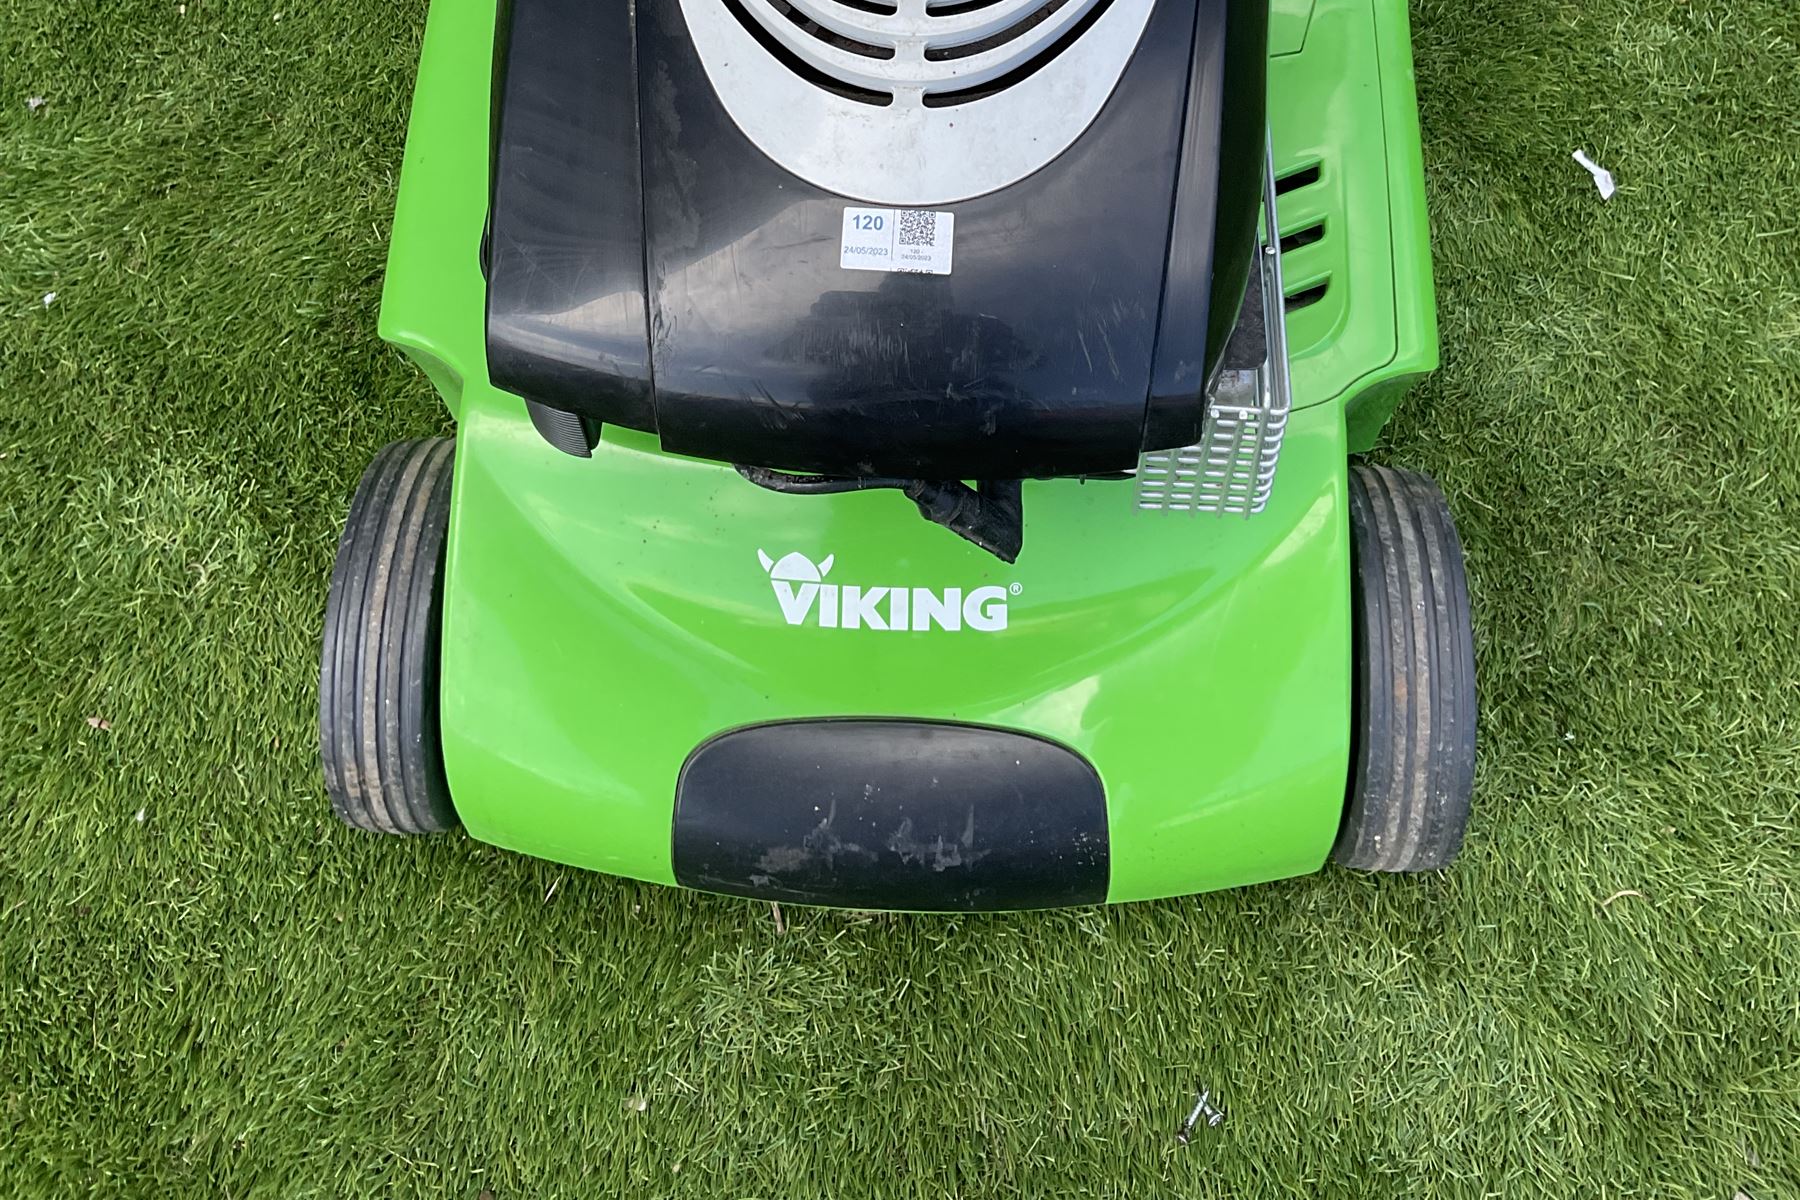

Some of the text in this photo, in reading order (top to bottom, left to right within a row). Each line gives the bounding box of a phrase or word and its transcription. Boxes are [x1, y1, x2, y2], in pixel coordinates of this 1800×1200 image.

[852, 214, 884, 231] 120
[843, 246, 889, 256] 24/05/2023
[770, 579, 1008, 632] VIKING
